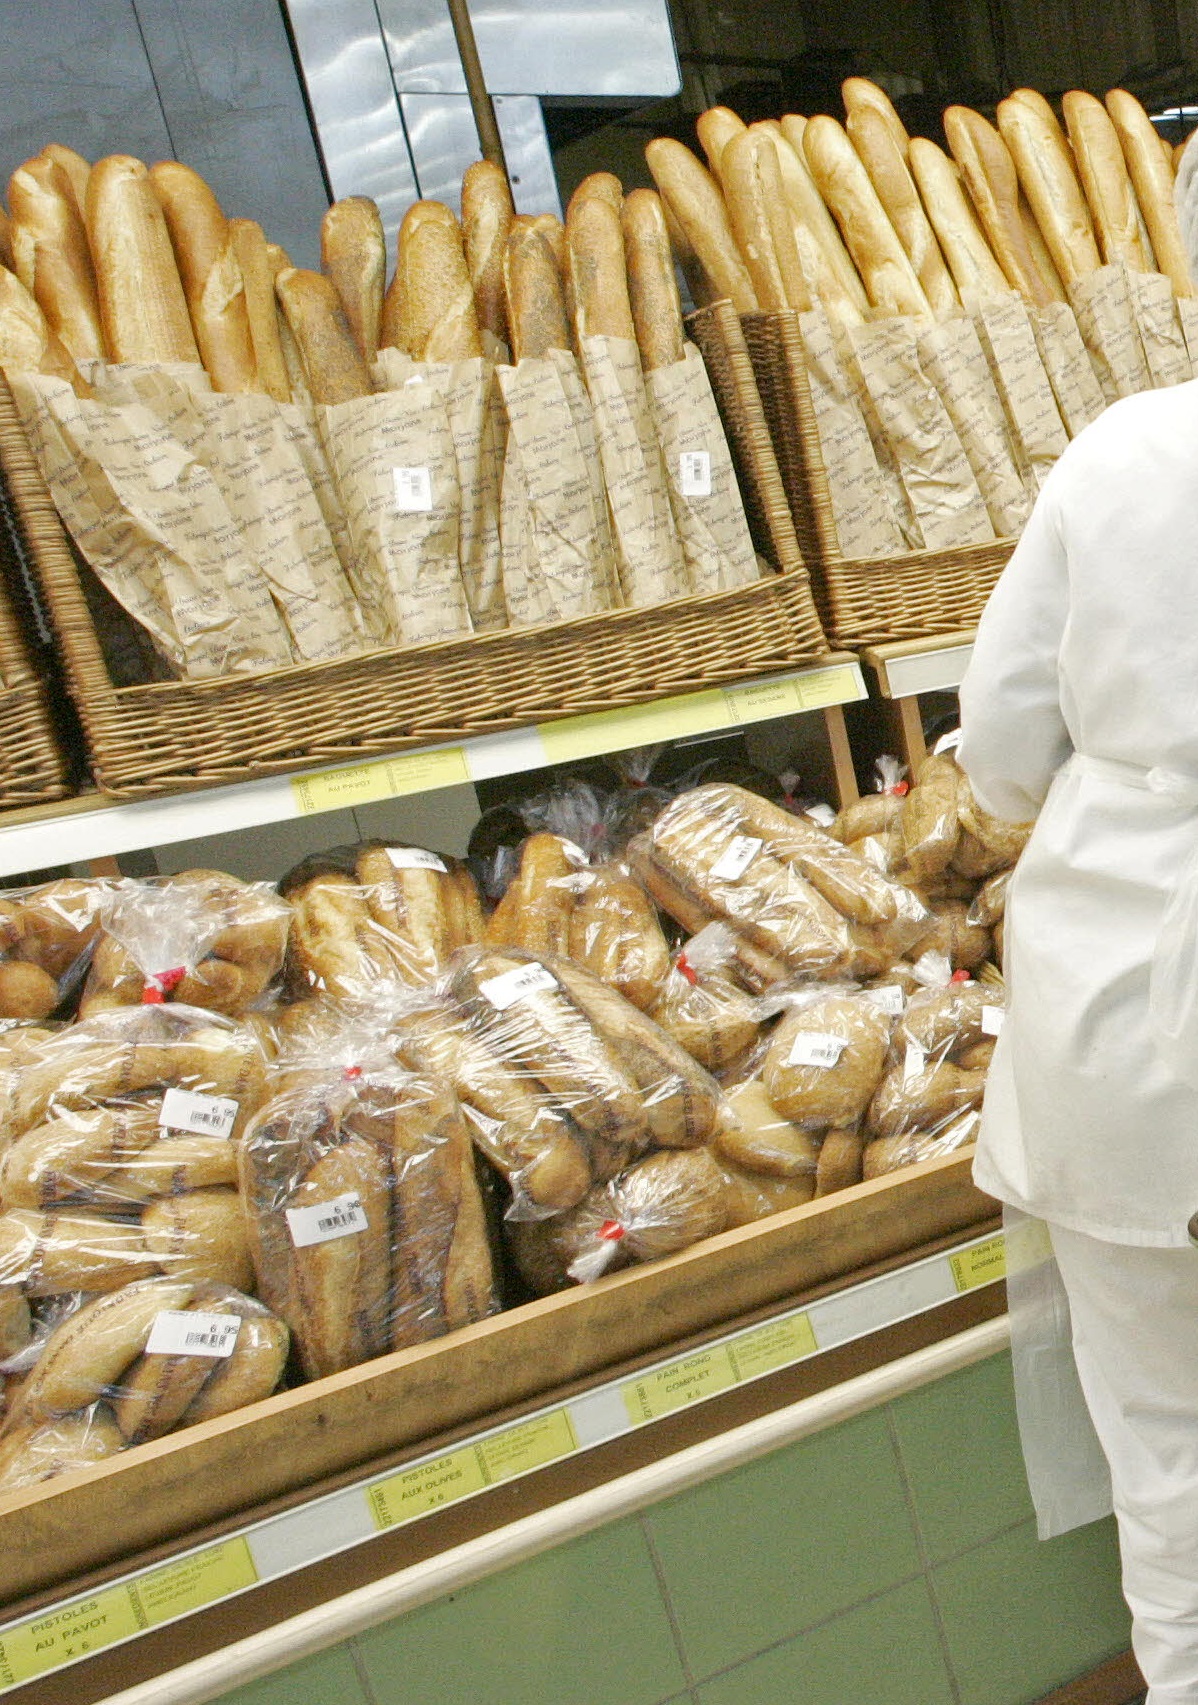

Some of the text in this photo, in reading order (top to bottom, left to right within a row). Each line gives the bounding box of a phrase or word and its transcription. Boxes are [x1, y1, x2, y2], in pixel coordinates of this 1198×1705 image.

[665, 1369, 711, 1394] COMPLET
[401, 1457, 453, 1485] PISTOLES
[31, 1600, 99, 1635] PISTOLES
[35, 1614, 108, 1653] AU PAVOT
